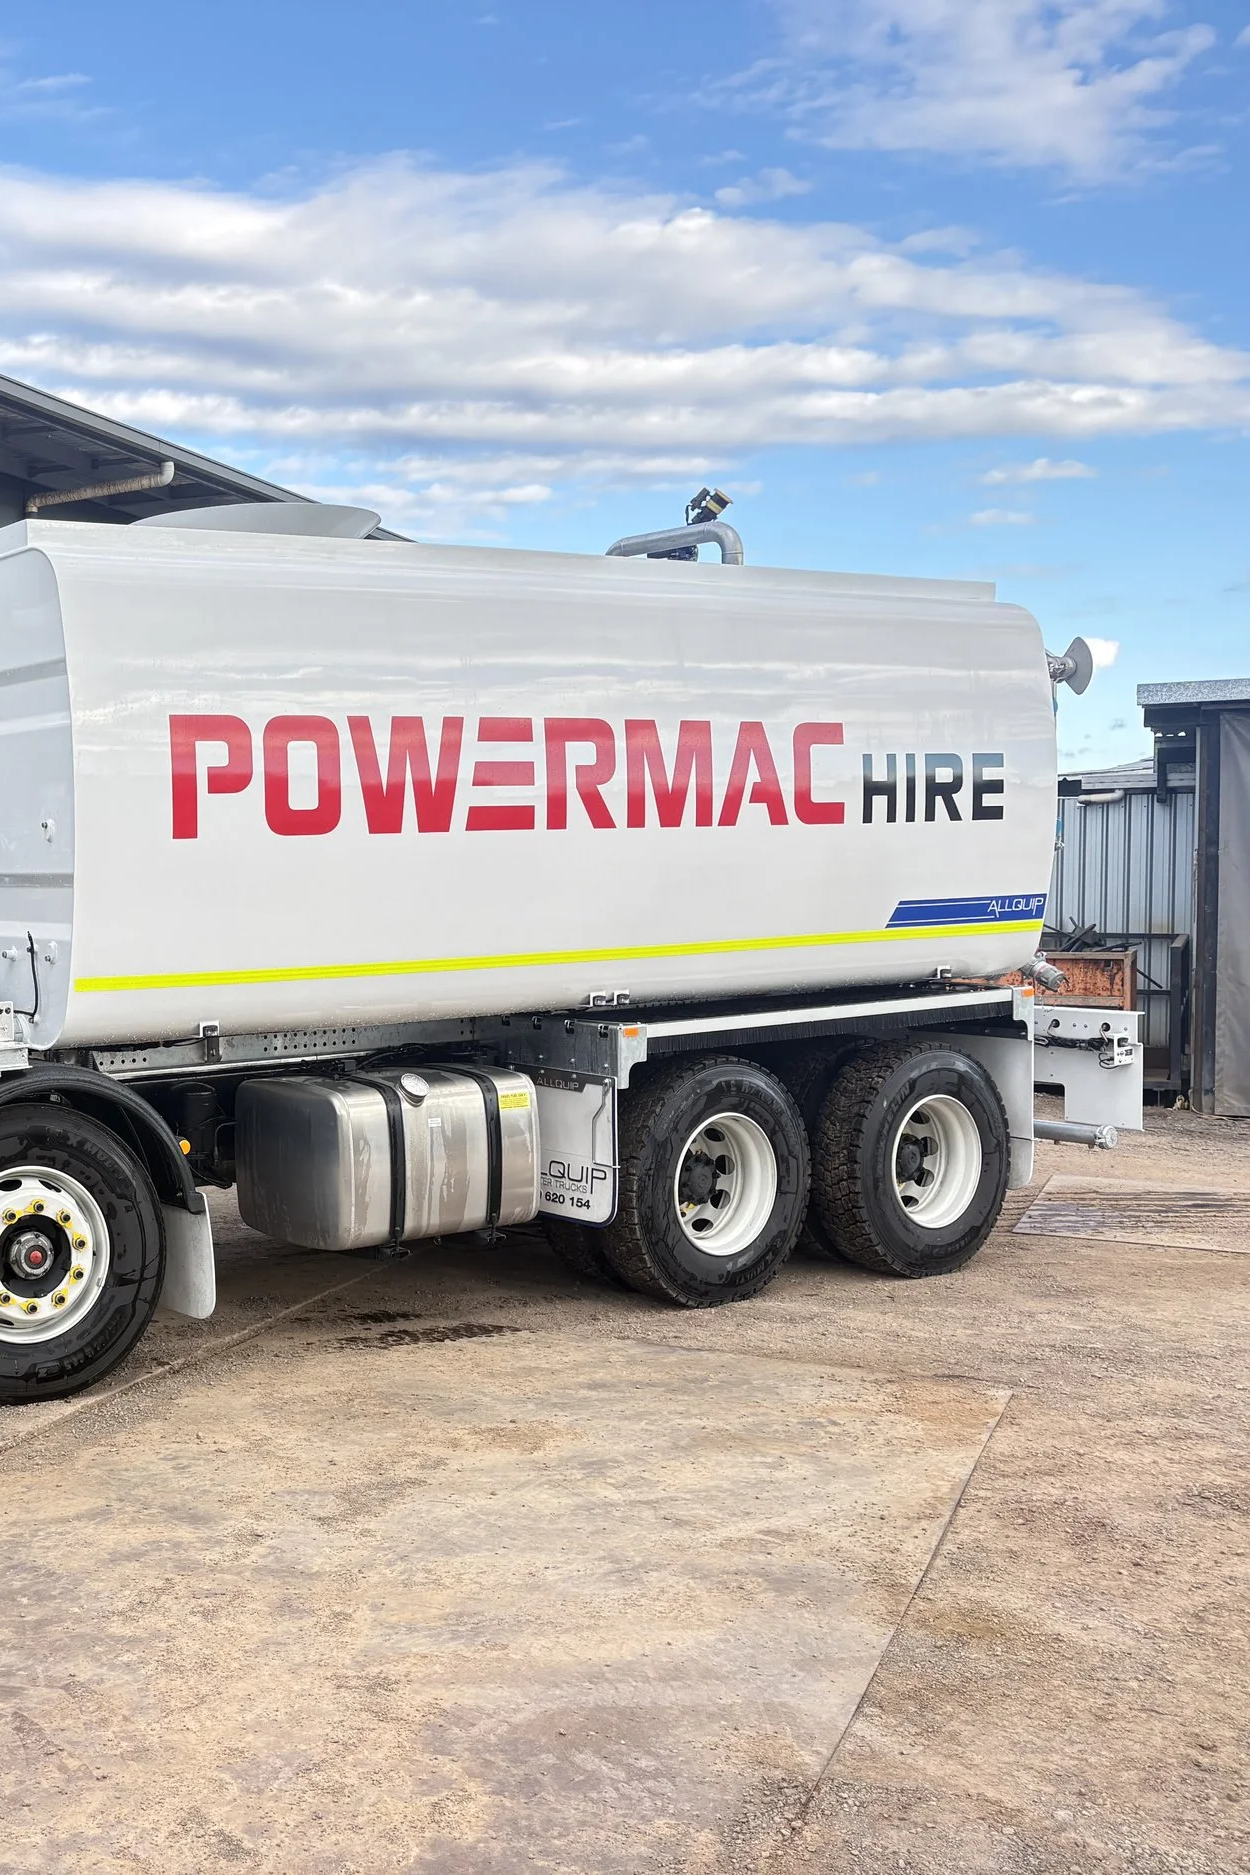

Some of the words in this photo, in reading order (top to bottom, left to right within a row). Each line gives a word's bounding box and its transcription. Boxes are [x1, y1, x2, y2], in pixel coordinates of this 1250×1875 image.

[169, 714, 845, 839] POWERMAC
[861, 752, 1005, 825] HIRE
[986, 897, 1044, 918] ALLQUIP
[536, 1077, 579, 1090] ALLQUIP
[541, 1160, 607, 1195] QUIP
[541, 1177, 553, 1187] TER
[554, 1179, 588, 1194] TRUCKS
[545, 1191, 565, 1204] 620
[569, 1196, 591, 1210] 154
